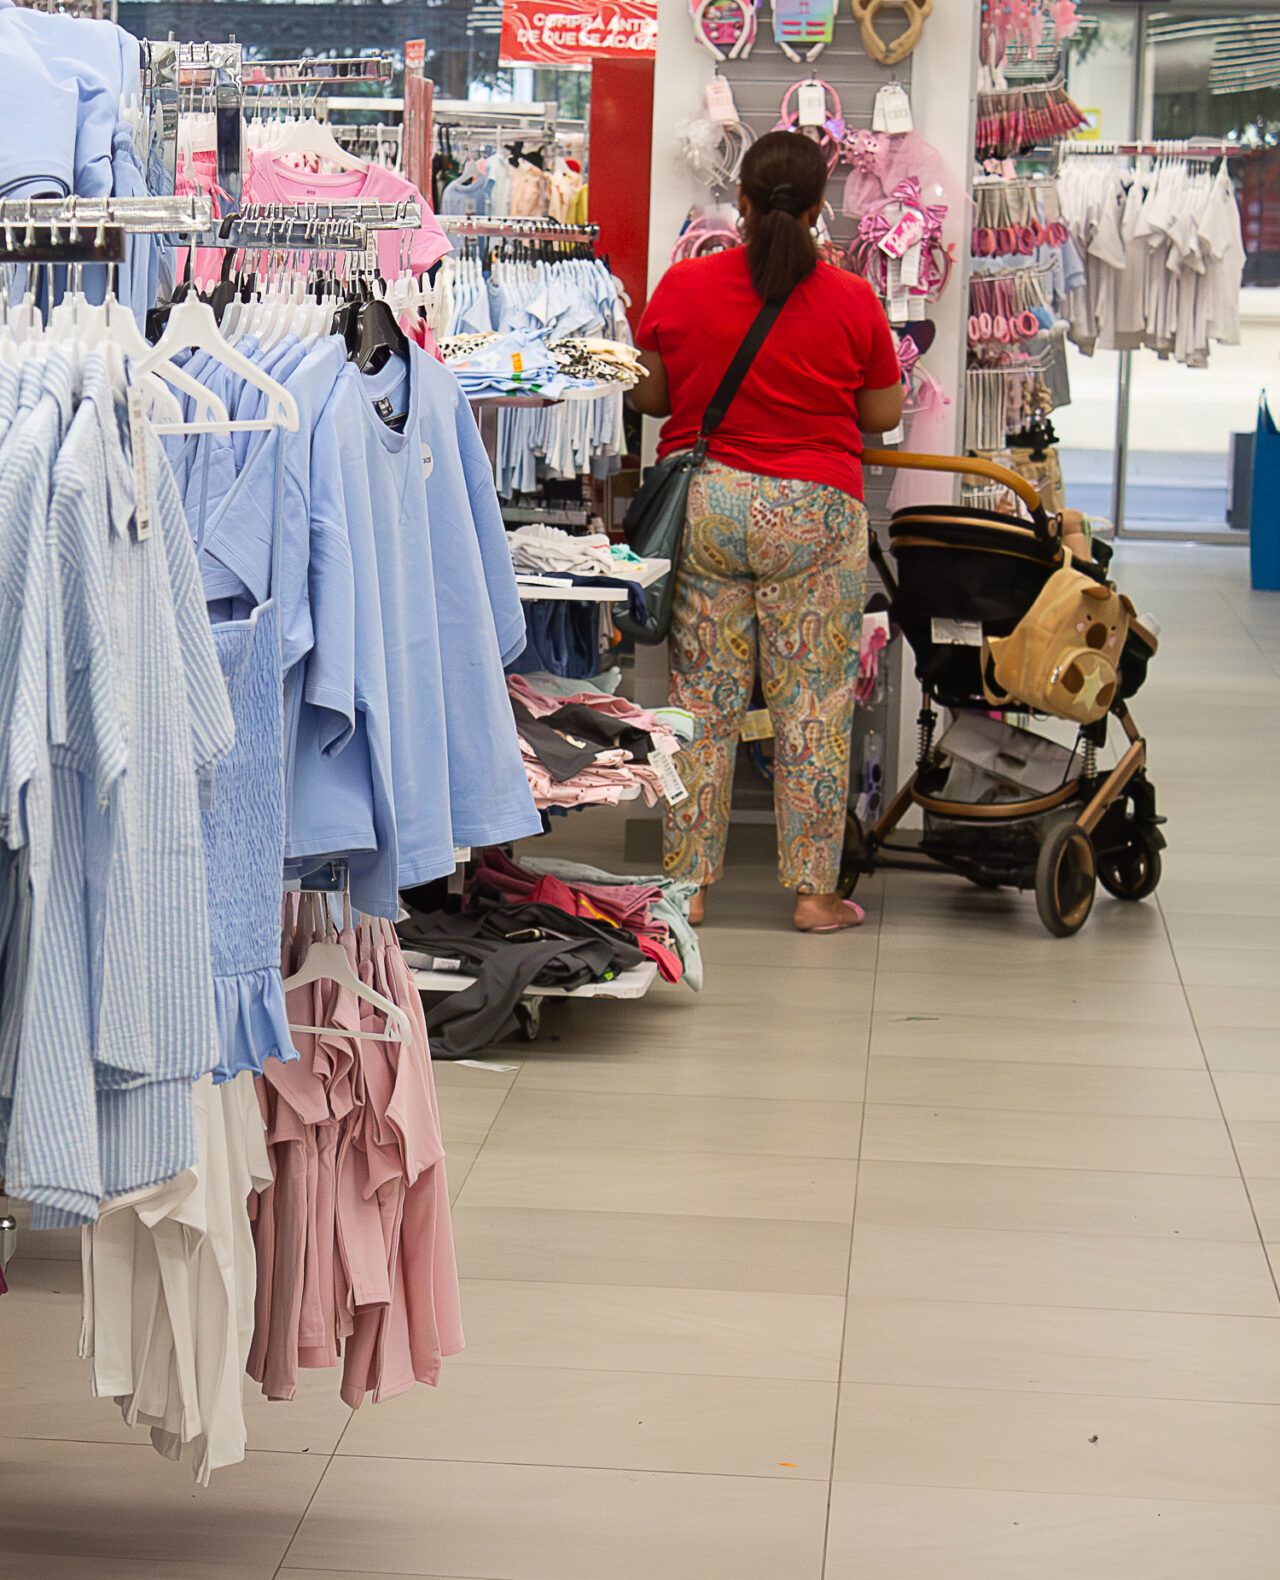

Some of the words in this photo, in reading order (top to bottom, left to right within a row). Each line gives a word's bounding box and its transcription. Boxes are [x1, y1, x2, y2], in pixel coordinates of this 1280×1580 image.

[533, 13, 605, 30] COMPRA
[517, 28, 540, 43] DE
[542, 30, 577, 46] QUE
